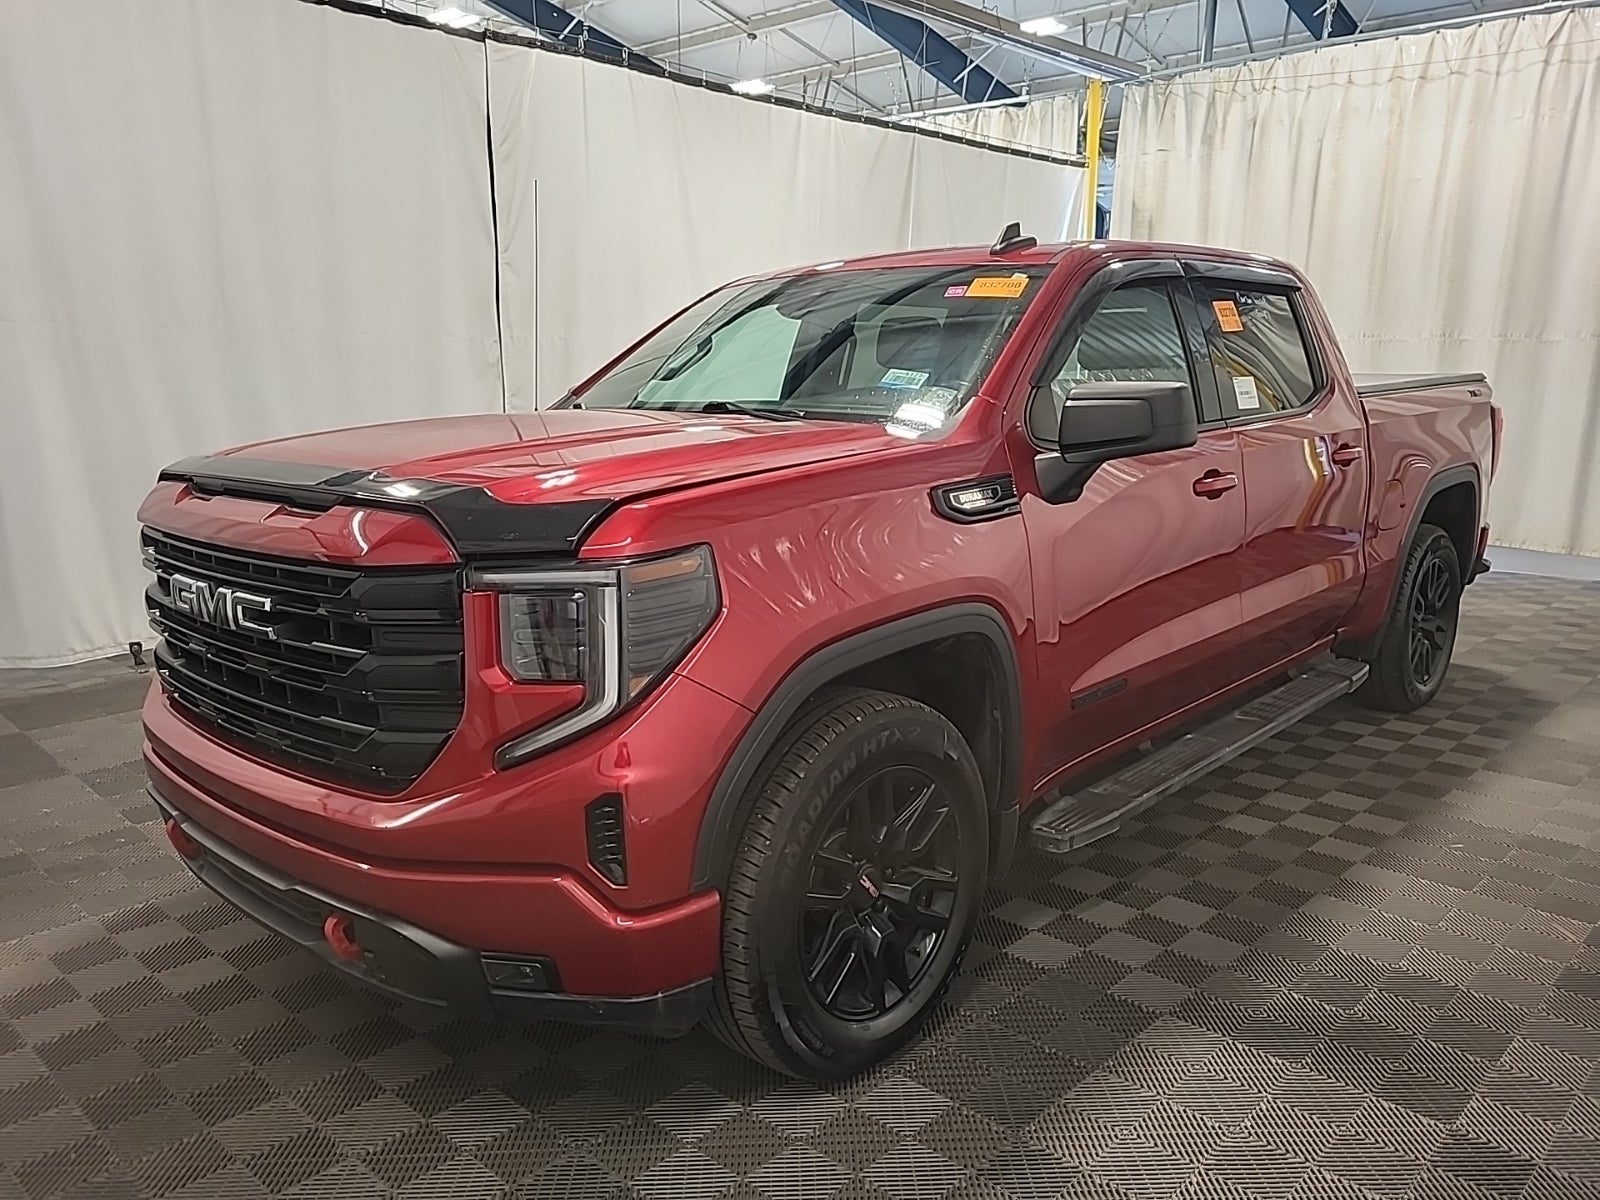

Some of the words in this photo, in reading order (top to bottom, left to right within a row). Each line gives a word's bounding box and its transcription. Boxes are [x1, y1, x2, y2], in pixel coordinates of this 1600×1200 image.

[979, 281, 1022, 289] 832700
[959, 489, 993, 503] DURAMAX
[170, 573, 278, 640] GMC
